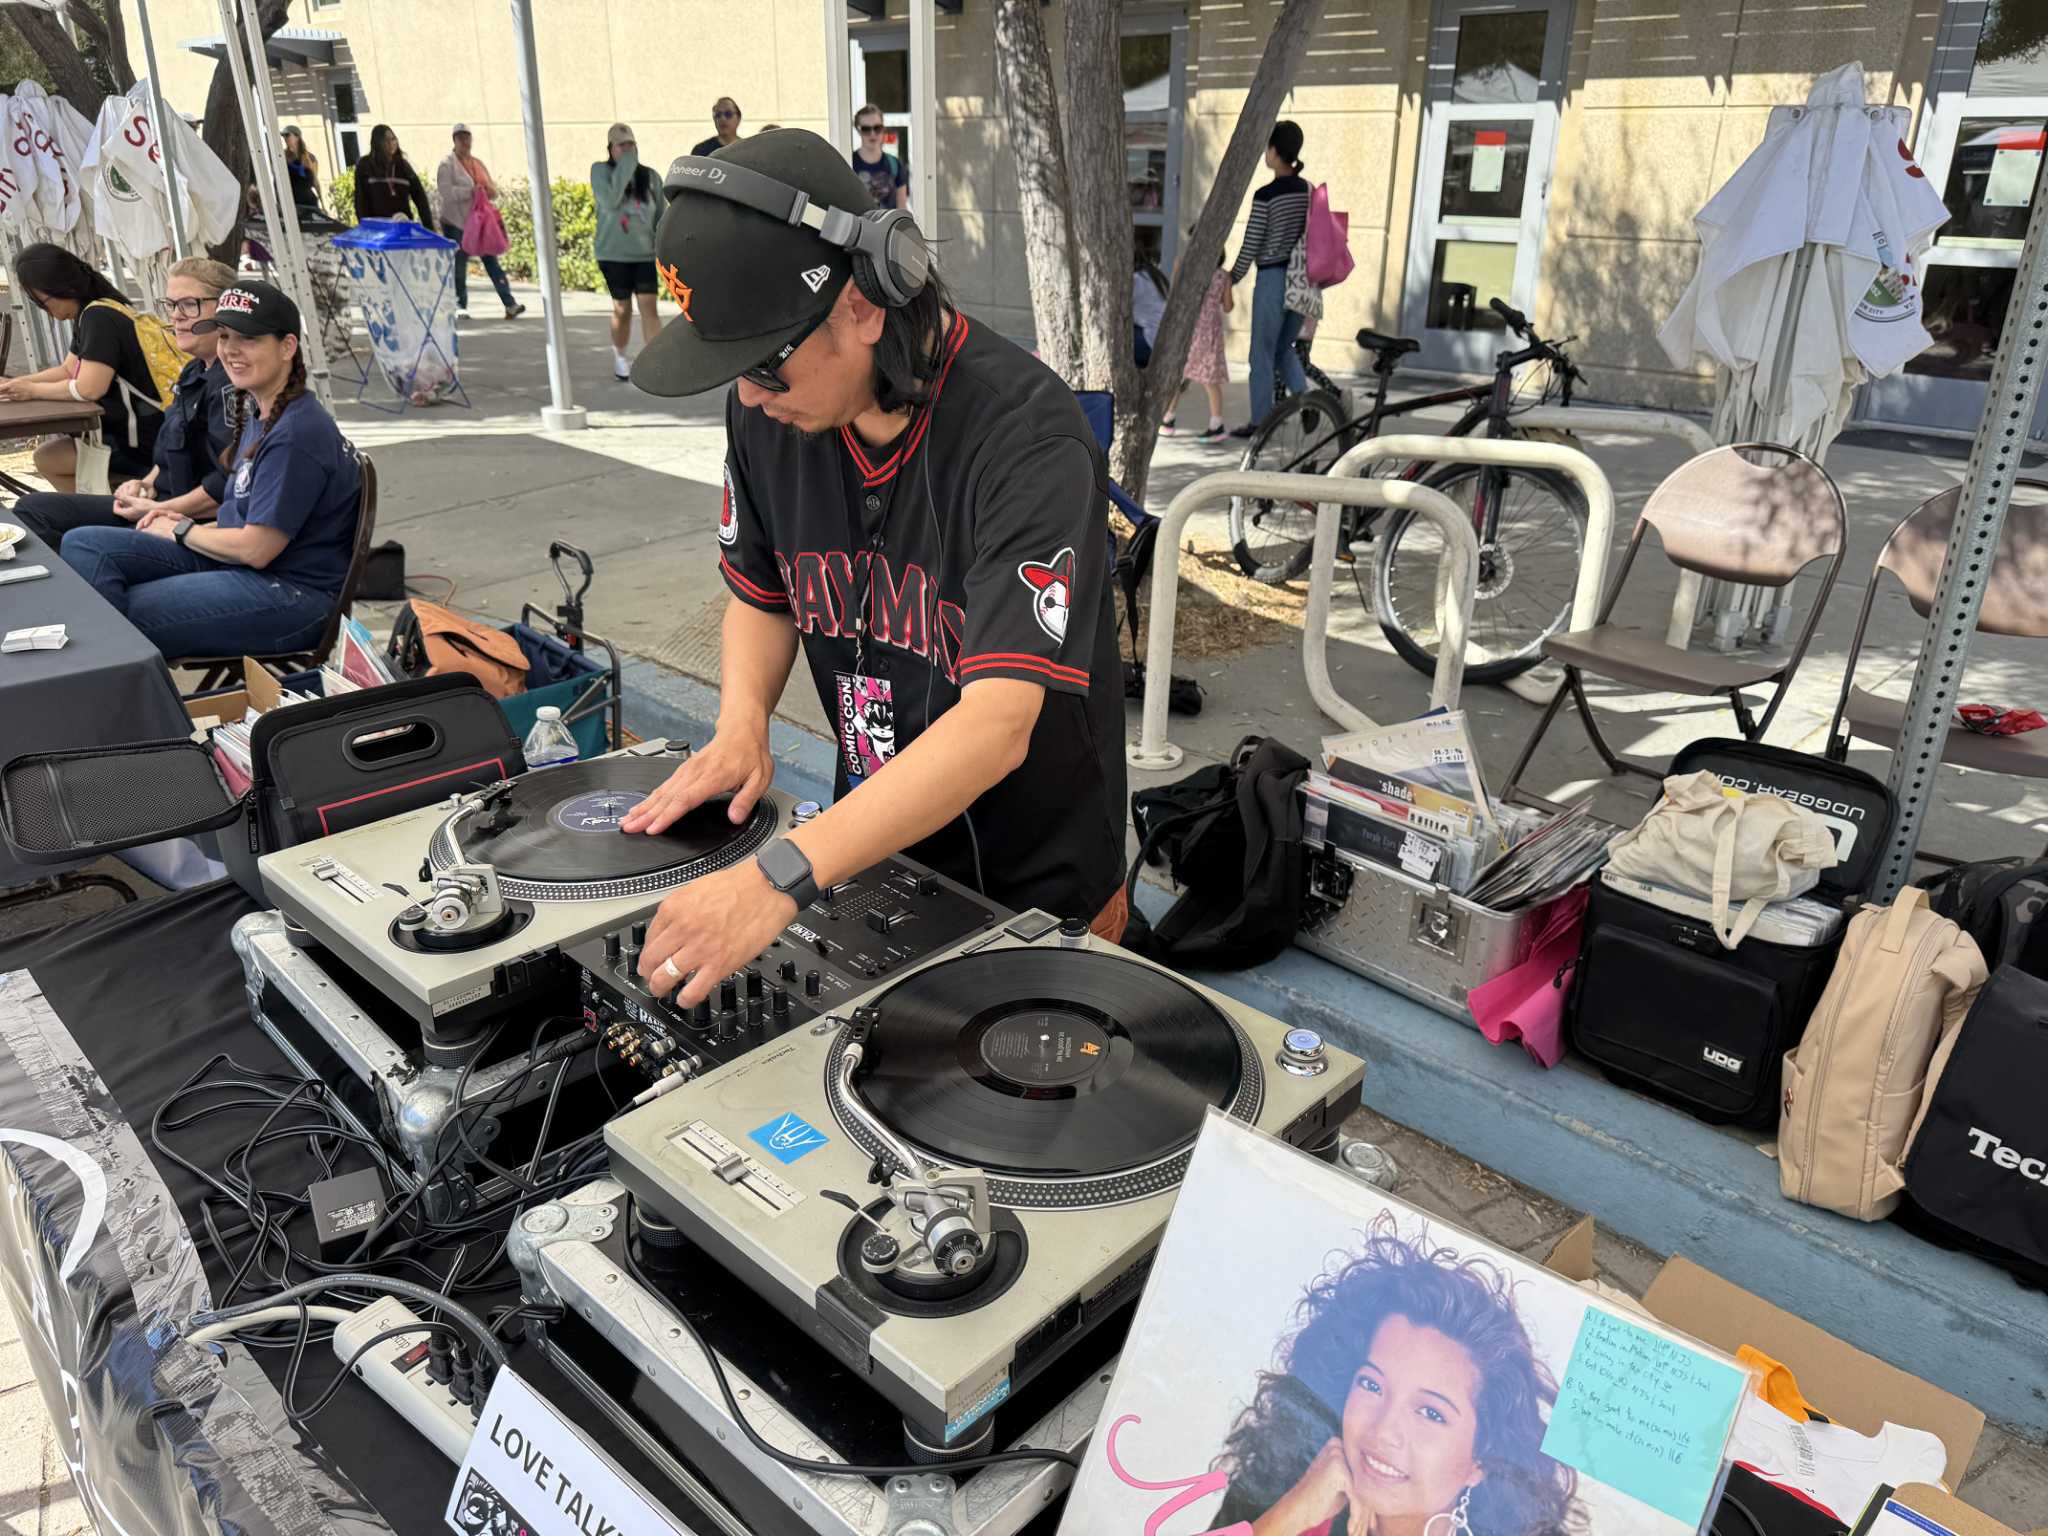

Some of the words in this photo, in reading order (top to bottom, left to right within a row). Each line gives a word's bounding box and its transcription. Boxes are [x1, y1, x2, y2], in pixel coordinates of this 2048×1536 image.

[671, 163, 706, 176] ioneer
[842, 682, 854, 719] CON
[844, 722, 862, 775] COMIC
[1715, 773, 1866, 821] UDGGEAR.CO
[1703, 1046, 1743, 1071] UDG
[489, 1413, 554, 1492] LOVE
[554, 1471, 623, 1536] TALK
